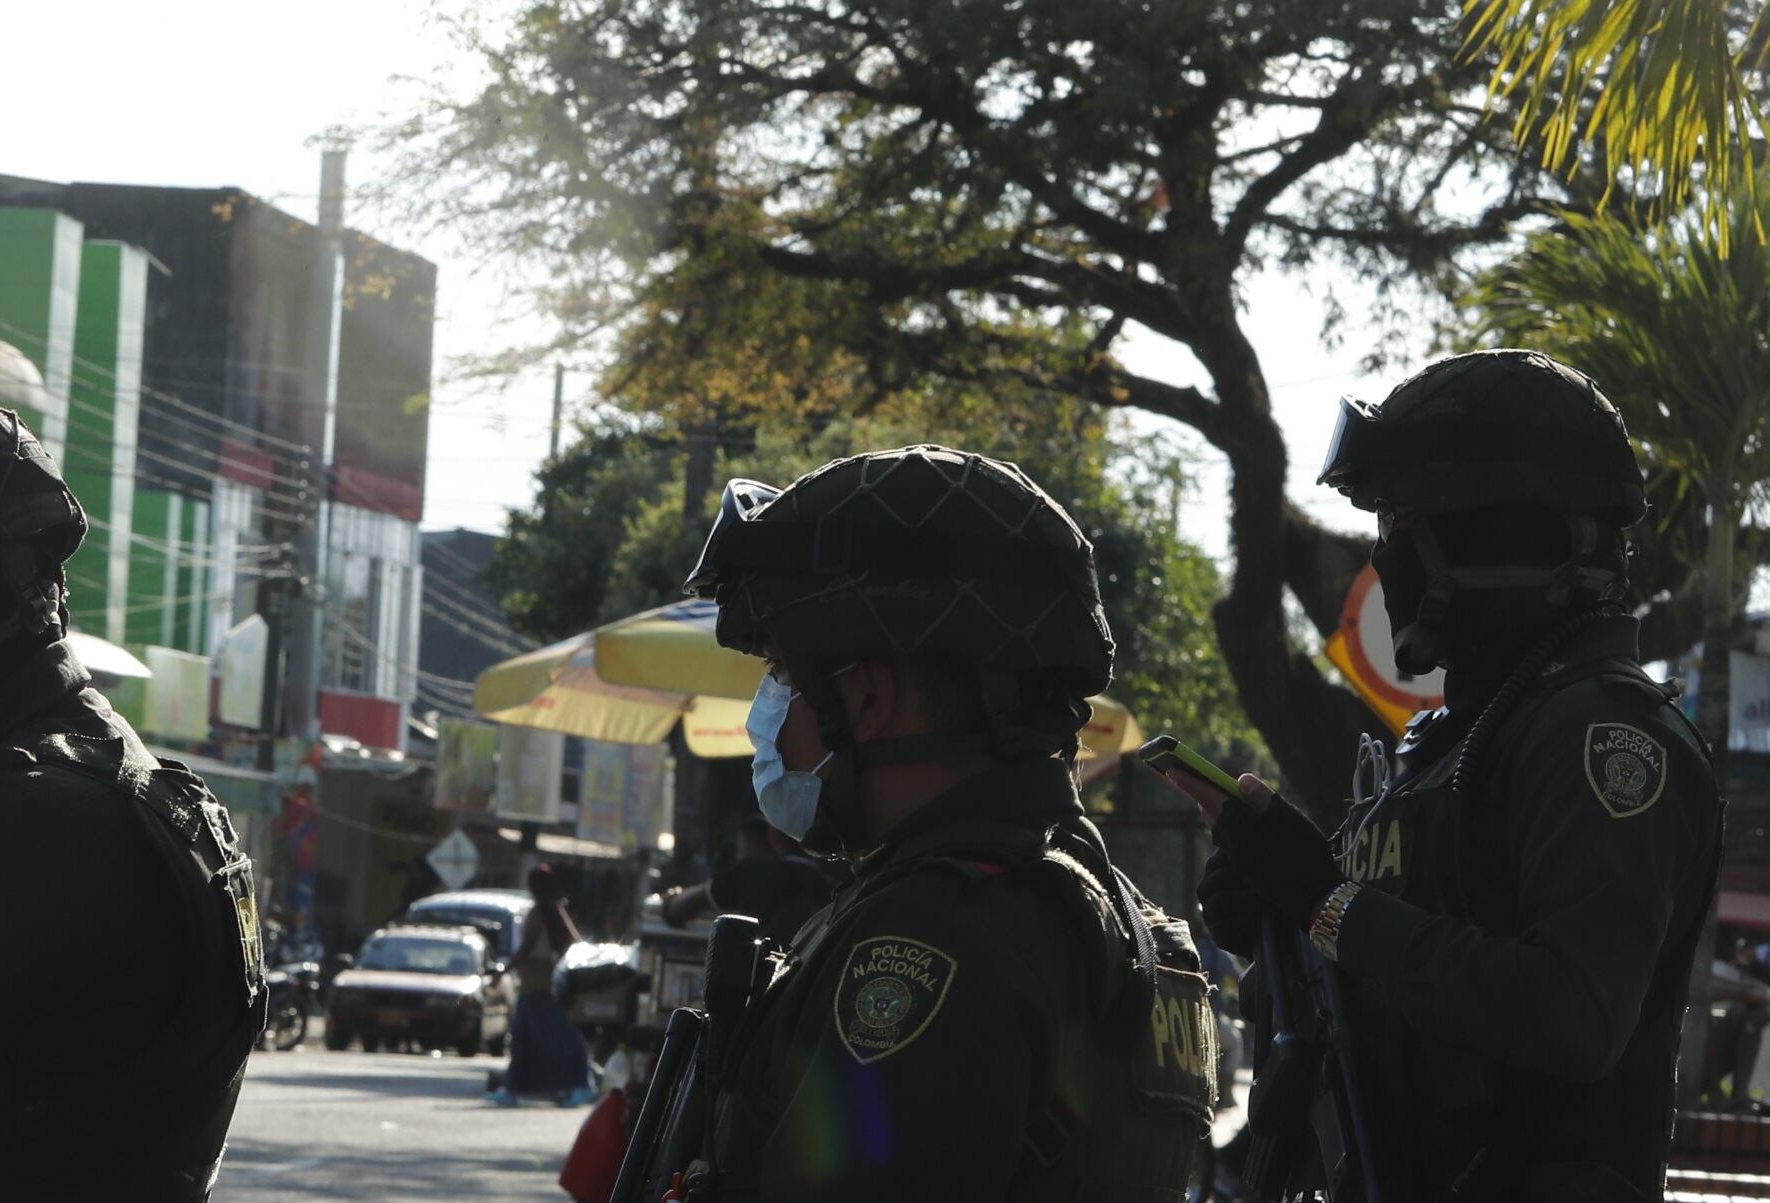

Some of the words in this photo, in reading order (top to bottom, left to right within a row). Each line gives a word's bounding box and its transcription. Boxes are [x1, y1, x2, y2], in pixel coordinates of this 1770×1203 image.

[1592, 739, 1660, 773] NACIONAL
[871, 944, 933, 970] POLICÍA
[853, 958, 938, 992] NACIONAL
[848, 1034, 897, 1049] COLOMBIA
